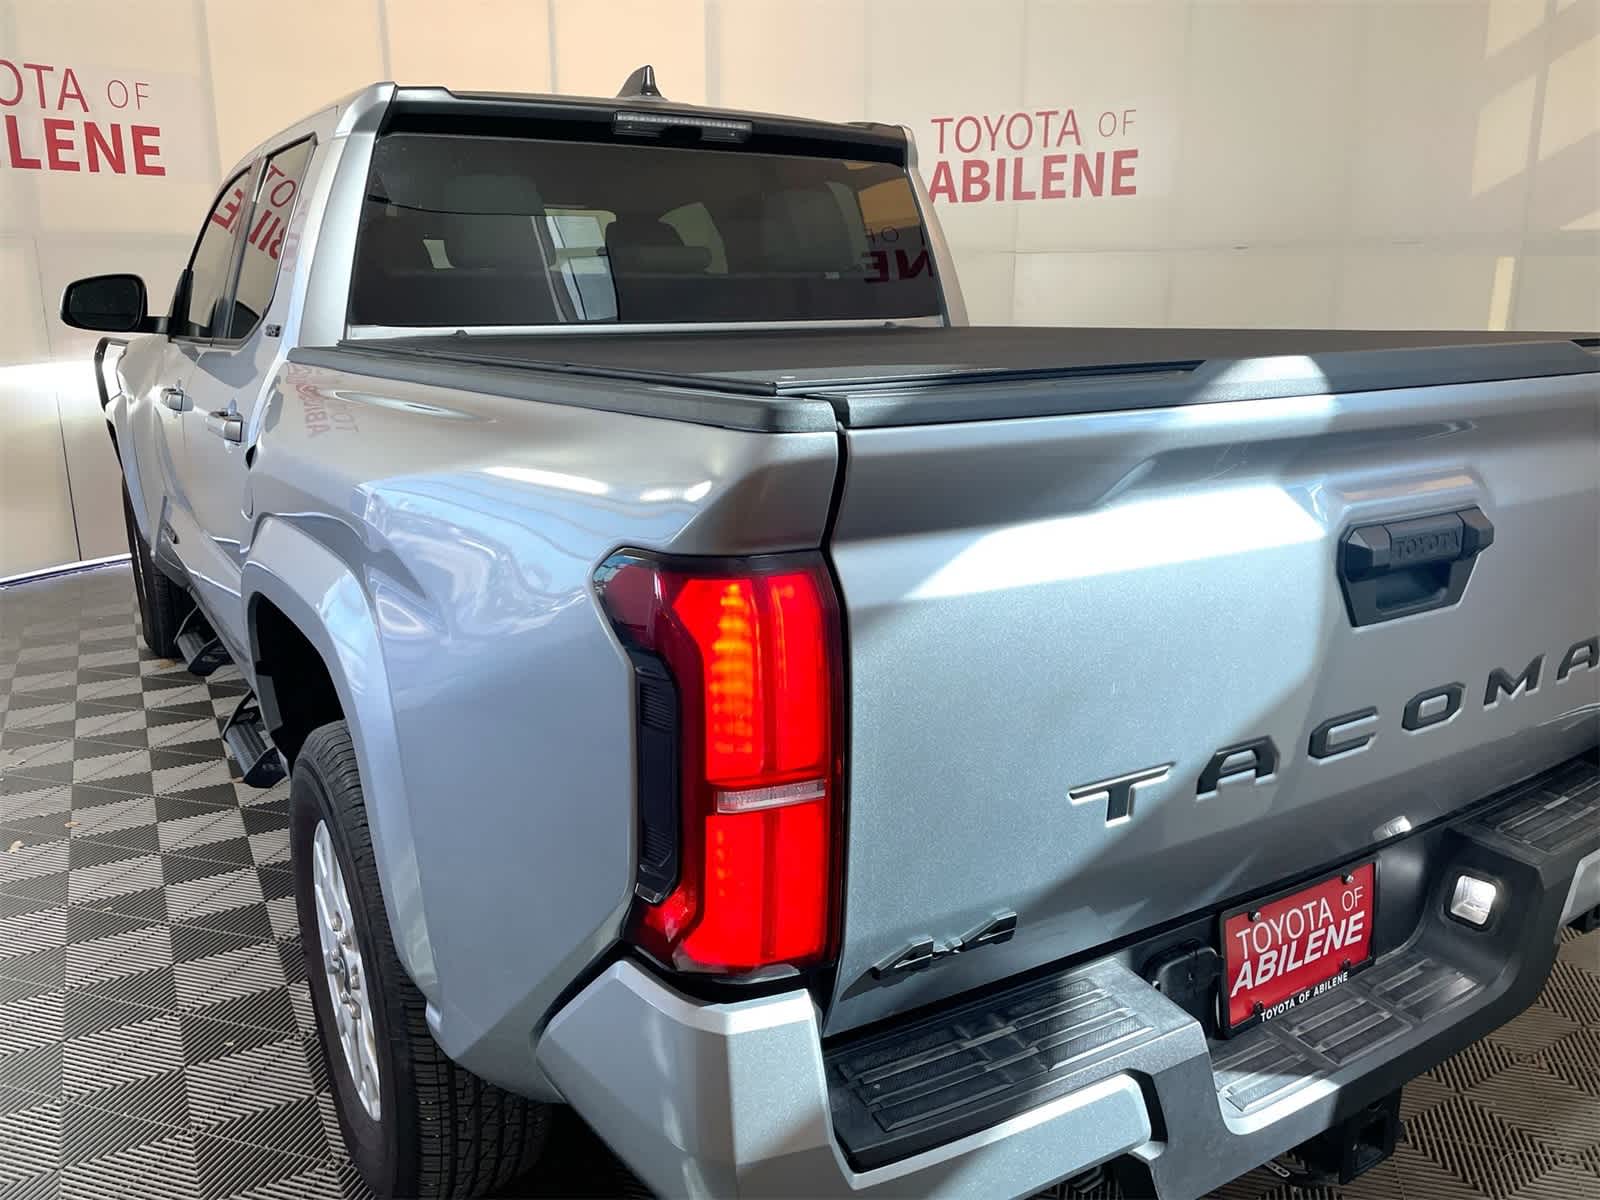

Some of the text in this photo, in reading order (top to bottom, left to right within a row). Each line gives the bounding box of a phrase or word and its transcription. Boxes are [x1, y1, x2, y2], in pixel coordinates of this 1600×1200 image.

[107, 79, 149, 111] OF
[931, 109, 1136, 154] TOYOTA OF
[929, 149, 1138, 204] ABILENE
[1067, 636, 1600, 828] TACOMA
[1236, 886, 1363, 960] TOYOTA OF
[1230, 911, 1365, 998] ABILENE
[1260, 971, 1349, 1023] TOYOTA OF ABILENE
